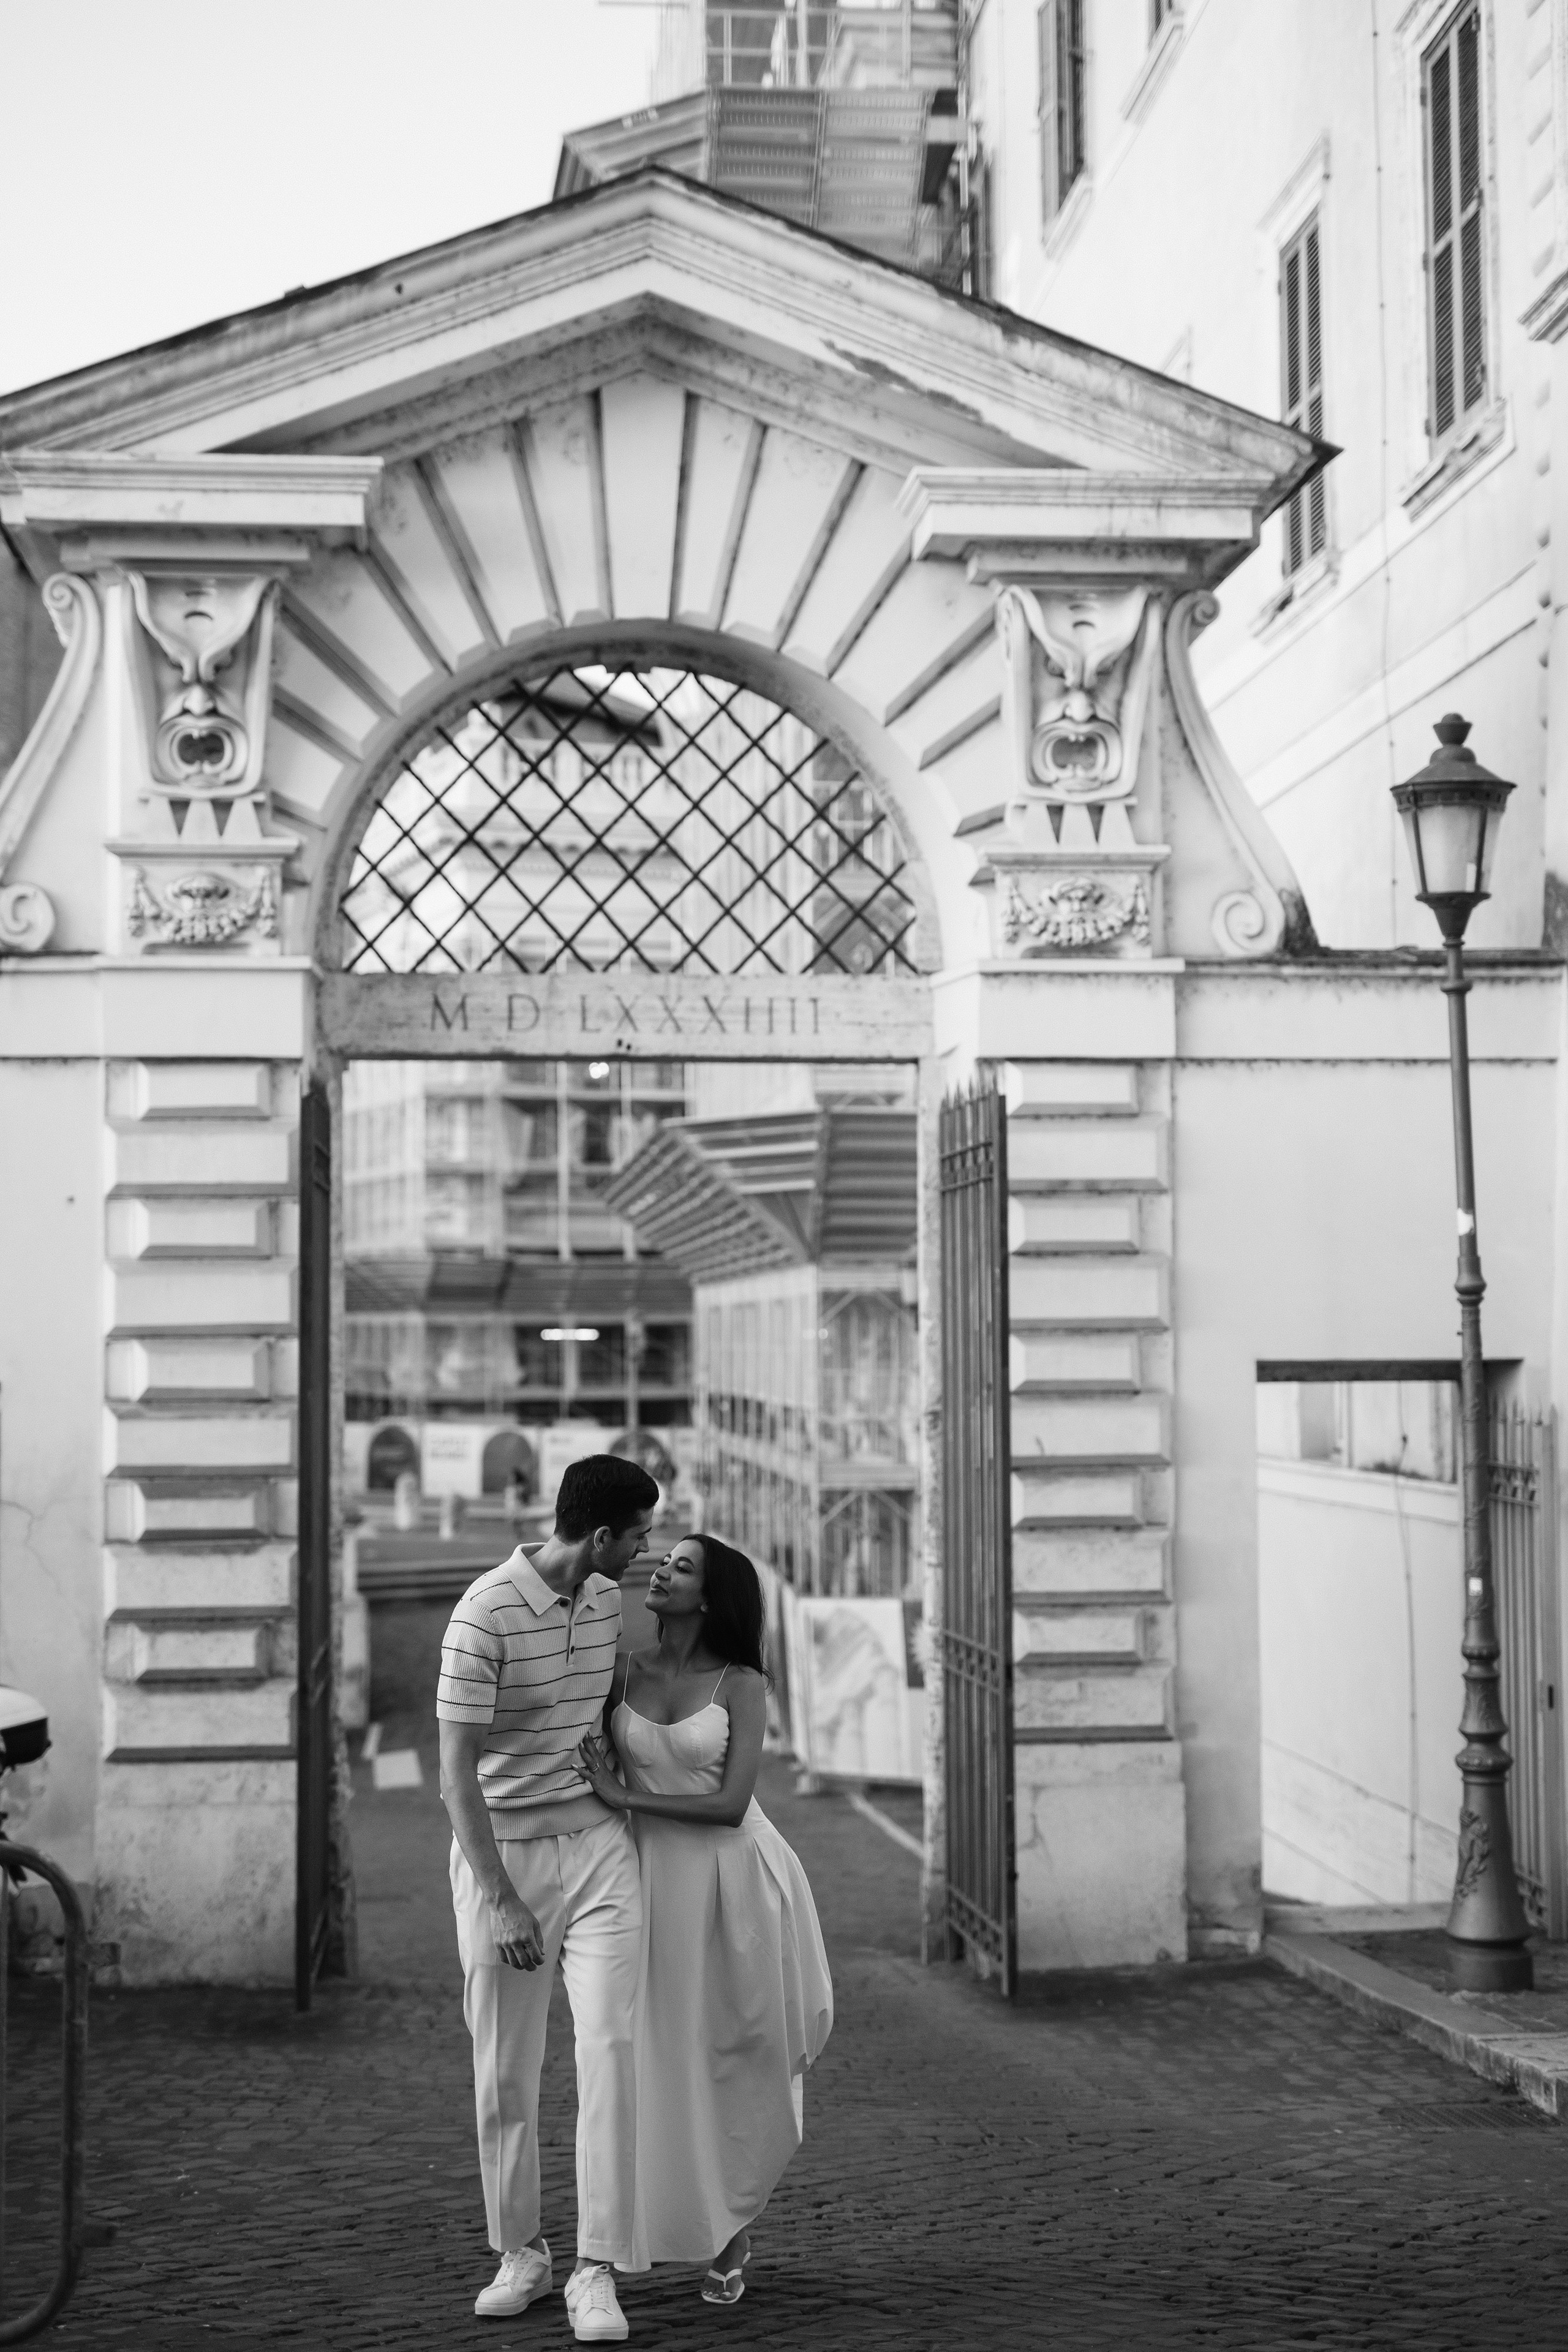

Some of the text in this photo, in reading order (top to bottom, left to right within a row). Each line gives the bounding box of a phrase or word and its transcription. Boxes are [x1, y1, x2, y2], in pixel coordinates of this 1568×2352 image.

[430, 992, 820, 1035] M D LXXXIIII
